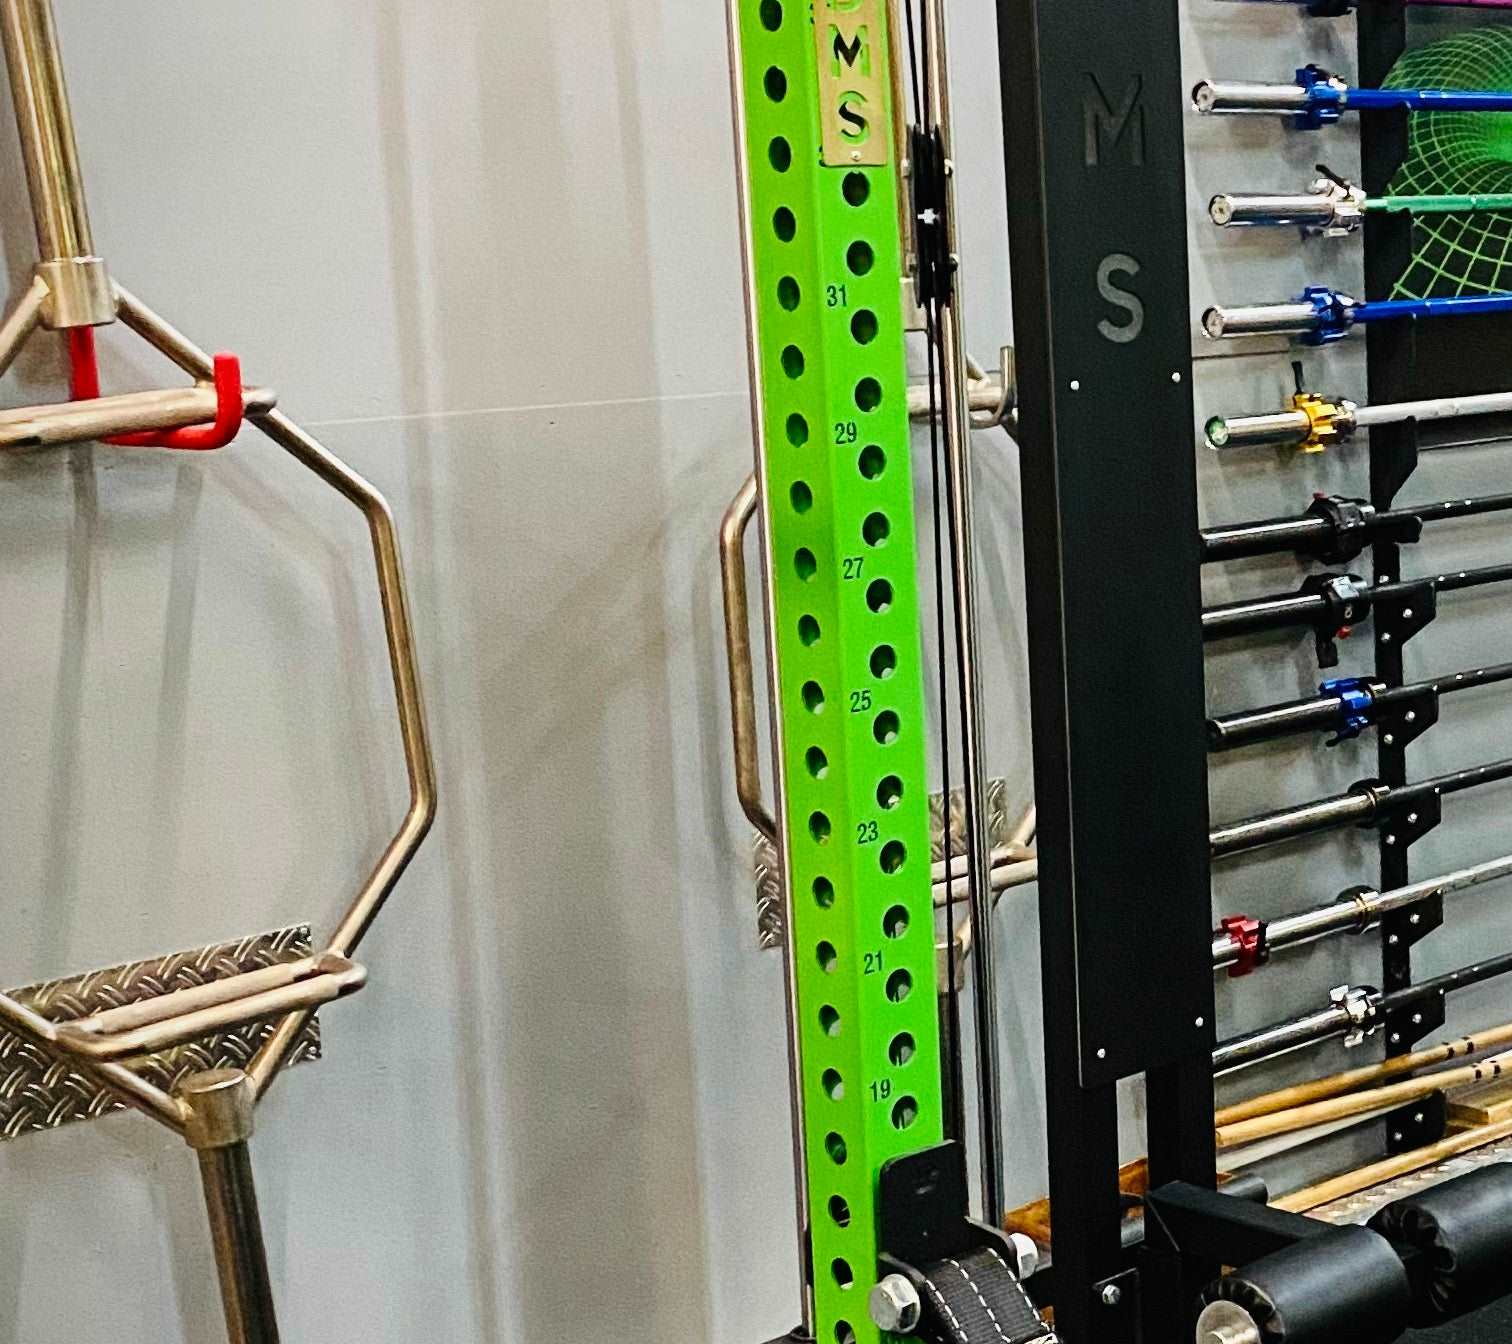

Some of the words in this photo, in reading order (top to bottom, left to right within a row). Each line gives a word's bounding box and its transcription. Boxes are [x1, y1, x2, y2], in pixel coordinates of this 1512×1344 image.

[826, 284, 848, 307] 31
[834, 422, 858, 445] 29
[842, 557, 865, 580] 27
[849, 689, 873, 713] 25
[856, 821, 880, 845] 23
[862, 951, 884, 975] 21
[868, 1078, 893, 1103] 19
